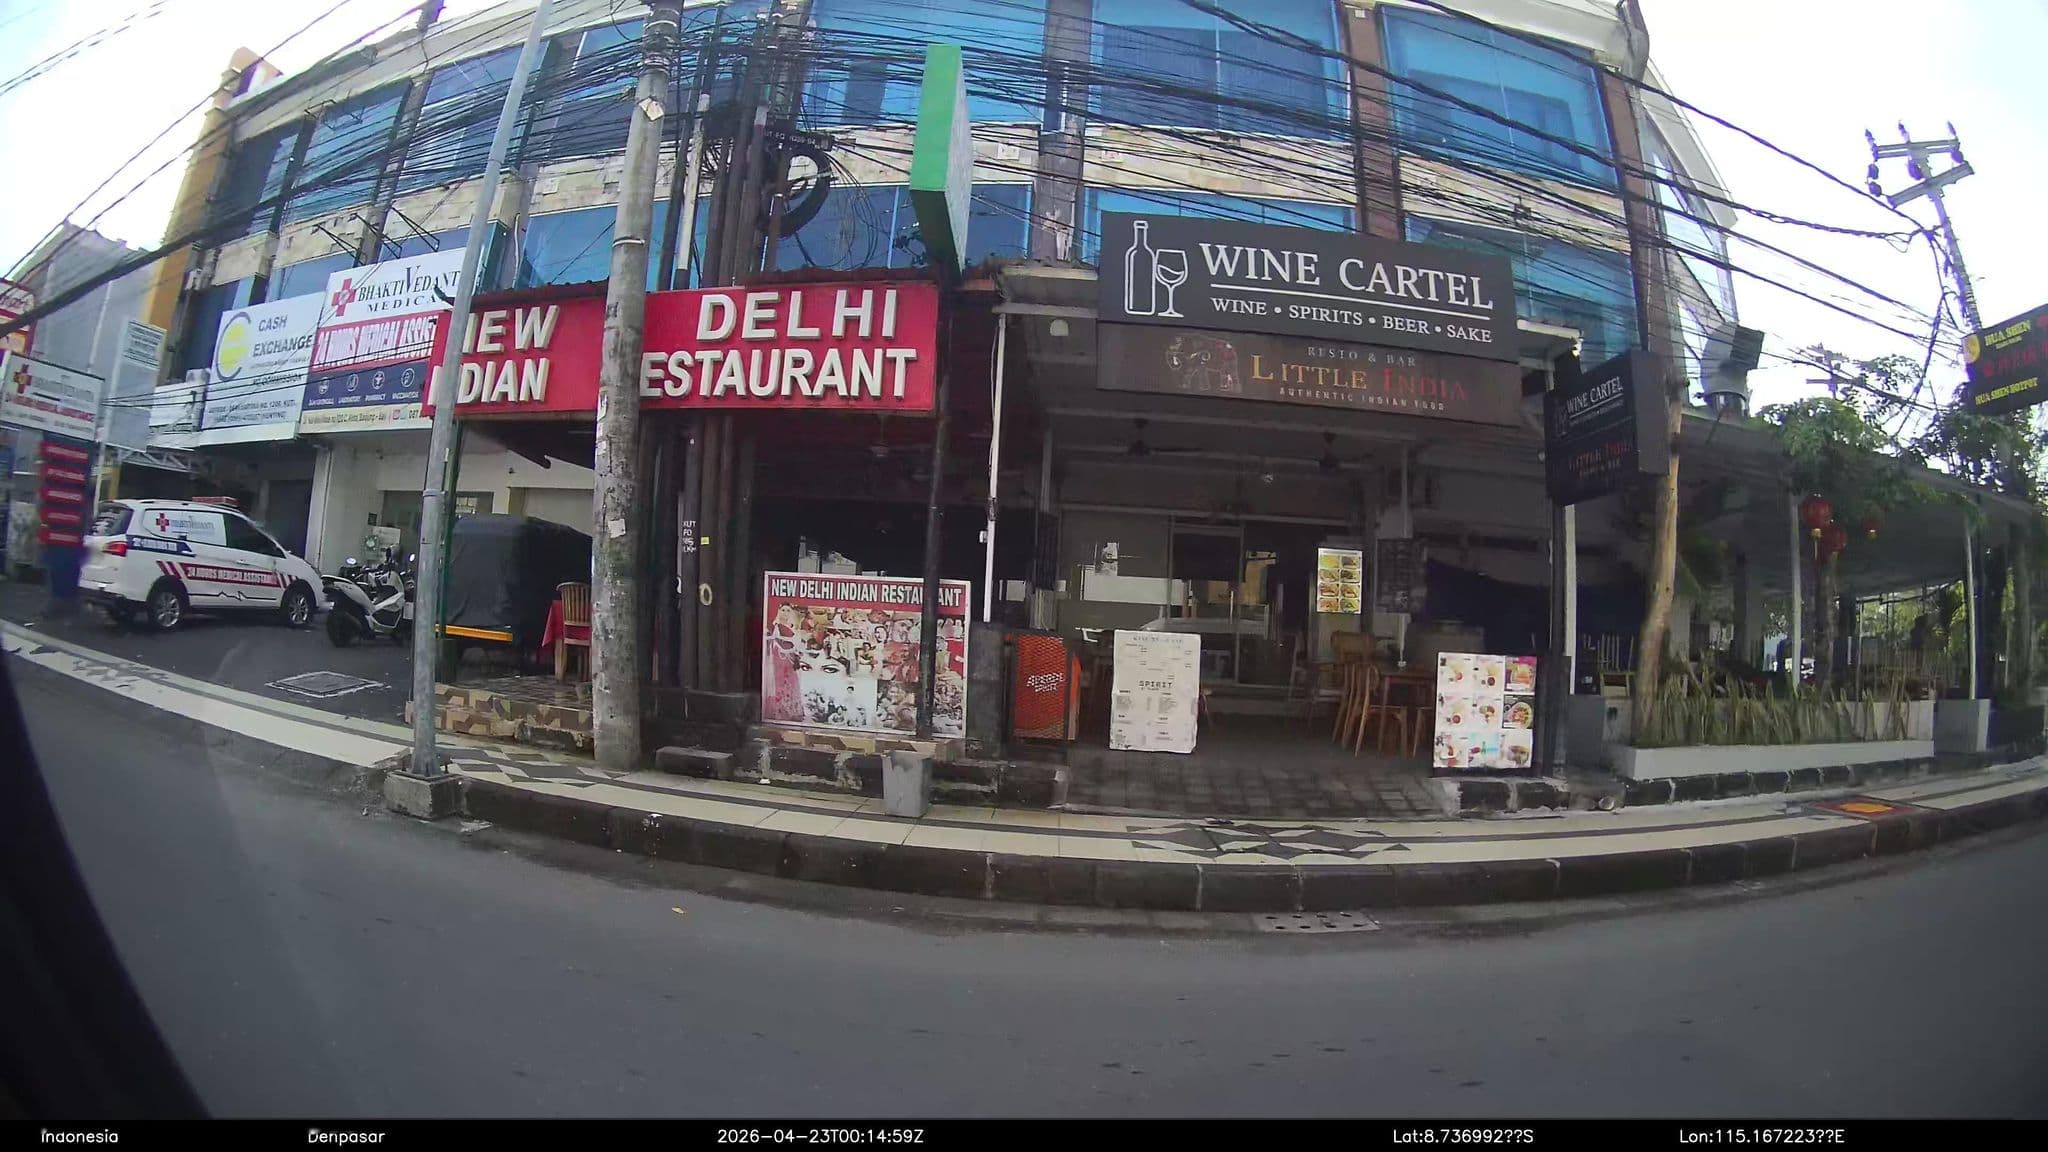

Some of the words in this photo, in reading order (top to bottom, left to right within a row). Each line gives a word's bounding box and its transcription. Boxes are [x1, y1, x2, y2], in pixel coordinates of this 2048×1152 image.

[359, 265, 461, 302] BHAKTIVEDANT
[1199, 243, 1321, 286] WINE
[1339, 258, 1494, 310] CARTEL
[368, 294, 437, 313] MEDICA
[696, 289, 897, 341] DELHI
[1210, 297, 1267, 315] WINE
[1289, 305, 1363, 325] SPIRITS
[1382, 315, 1430, 335] BEER
[1447, 324, 1493, 343] SAKE
[258, 314, 288, 332] CASH
[253, 334, 313, 357] EXCHANGE
[1307, 346, 1358, 360] RESTO
[1368, 353, 1376, 363] &
[1387, 356, 1416, 367] BAR
[428, 358, 550, 405] IDIAN
[639, 348, 918, 399] ESTAURANT
[1251, 355, 1368, 390] LITTLE
[1383, 368, 1466, 400] INDIA
[1279, 387, 1353, 401] AUTHENTIC
[1361, 394, 1407, 407] INDIAN
[1566, 392, 1588, 414] WINE
[1589, 376, 1624, 403] CARTEL
[771, 579, 797, 598] NEW
[800, 580, 833, 600] DELHI
[837, 582, 879, 602] INDIAN
[881, 584, 962, 607] RESTAANT
[1139, 680, 1172, 688] SPIRIT
